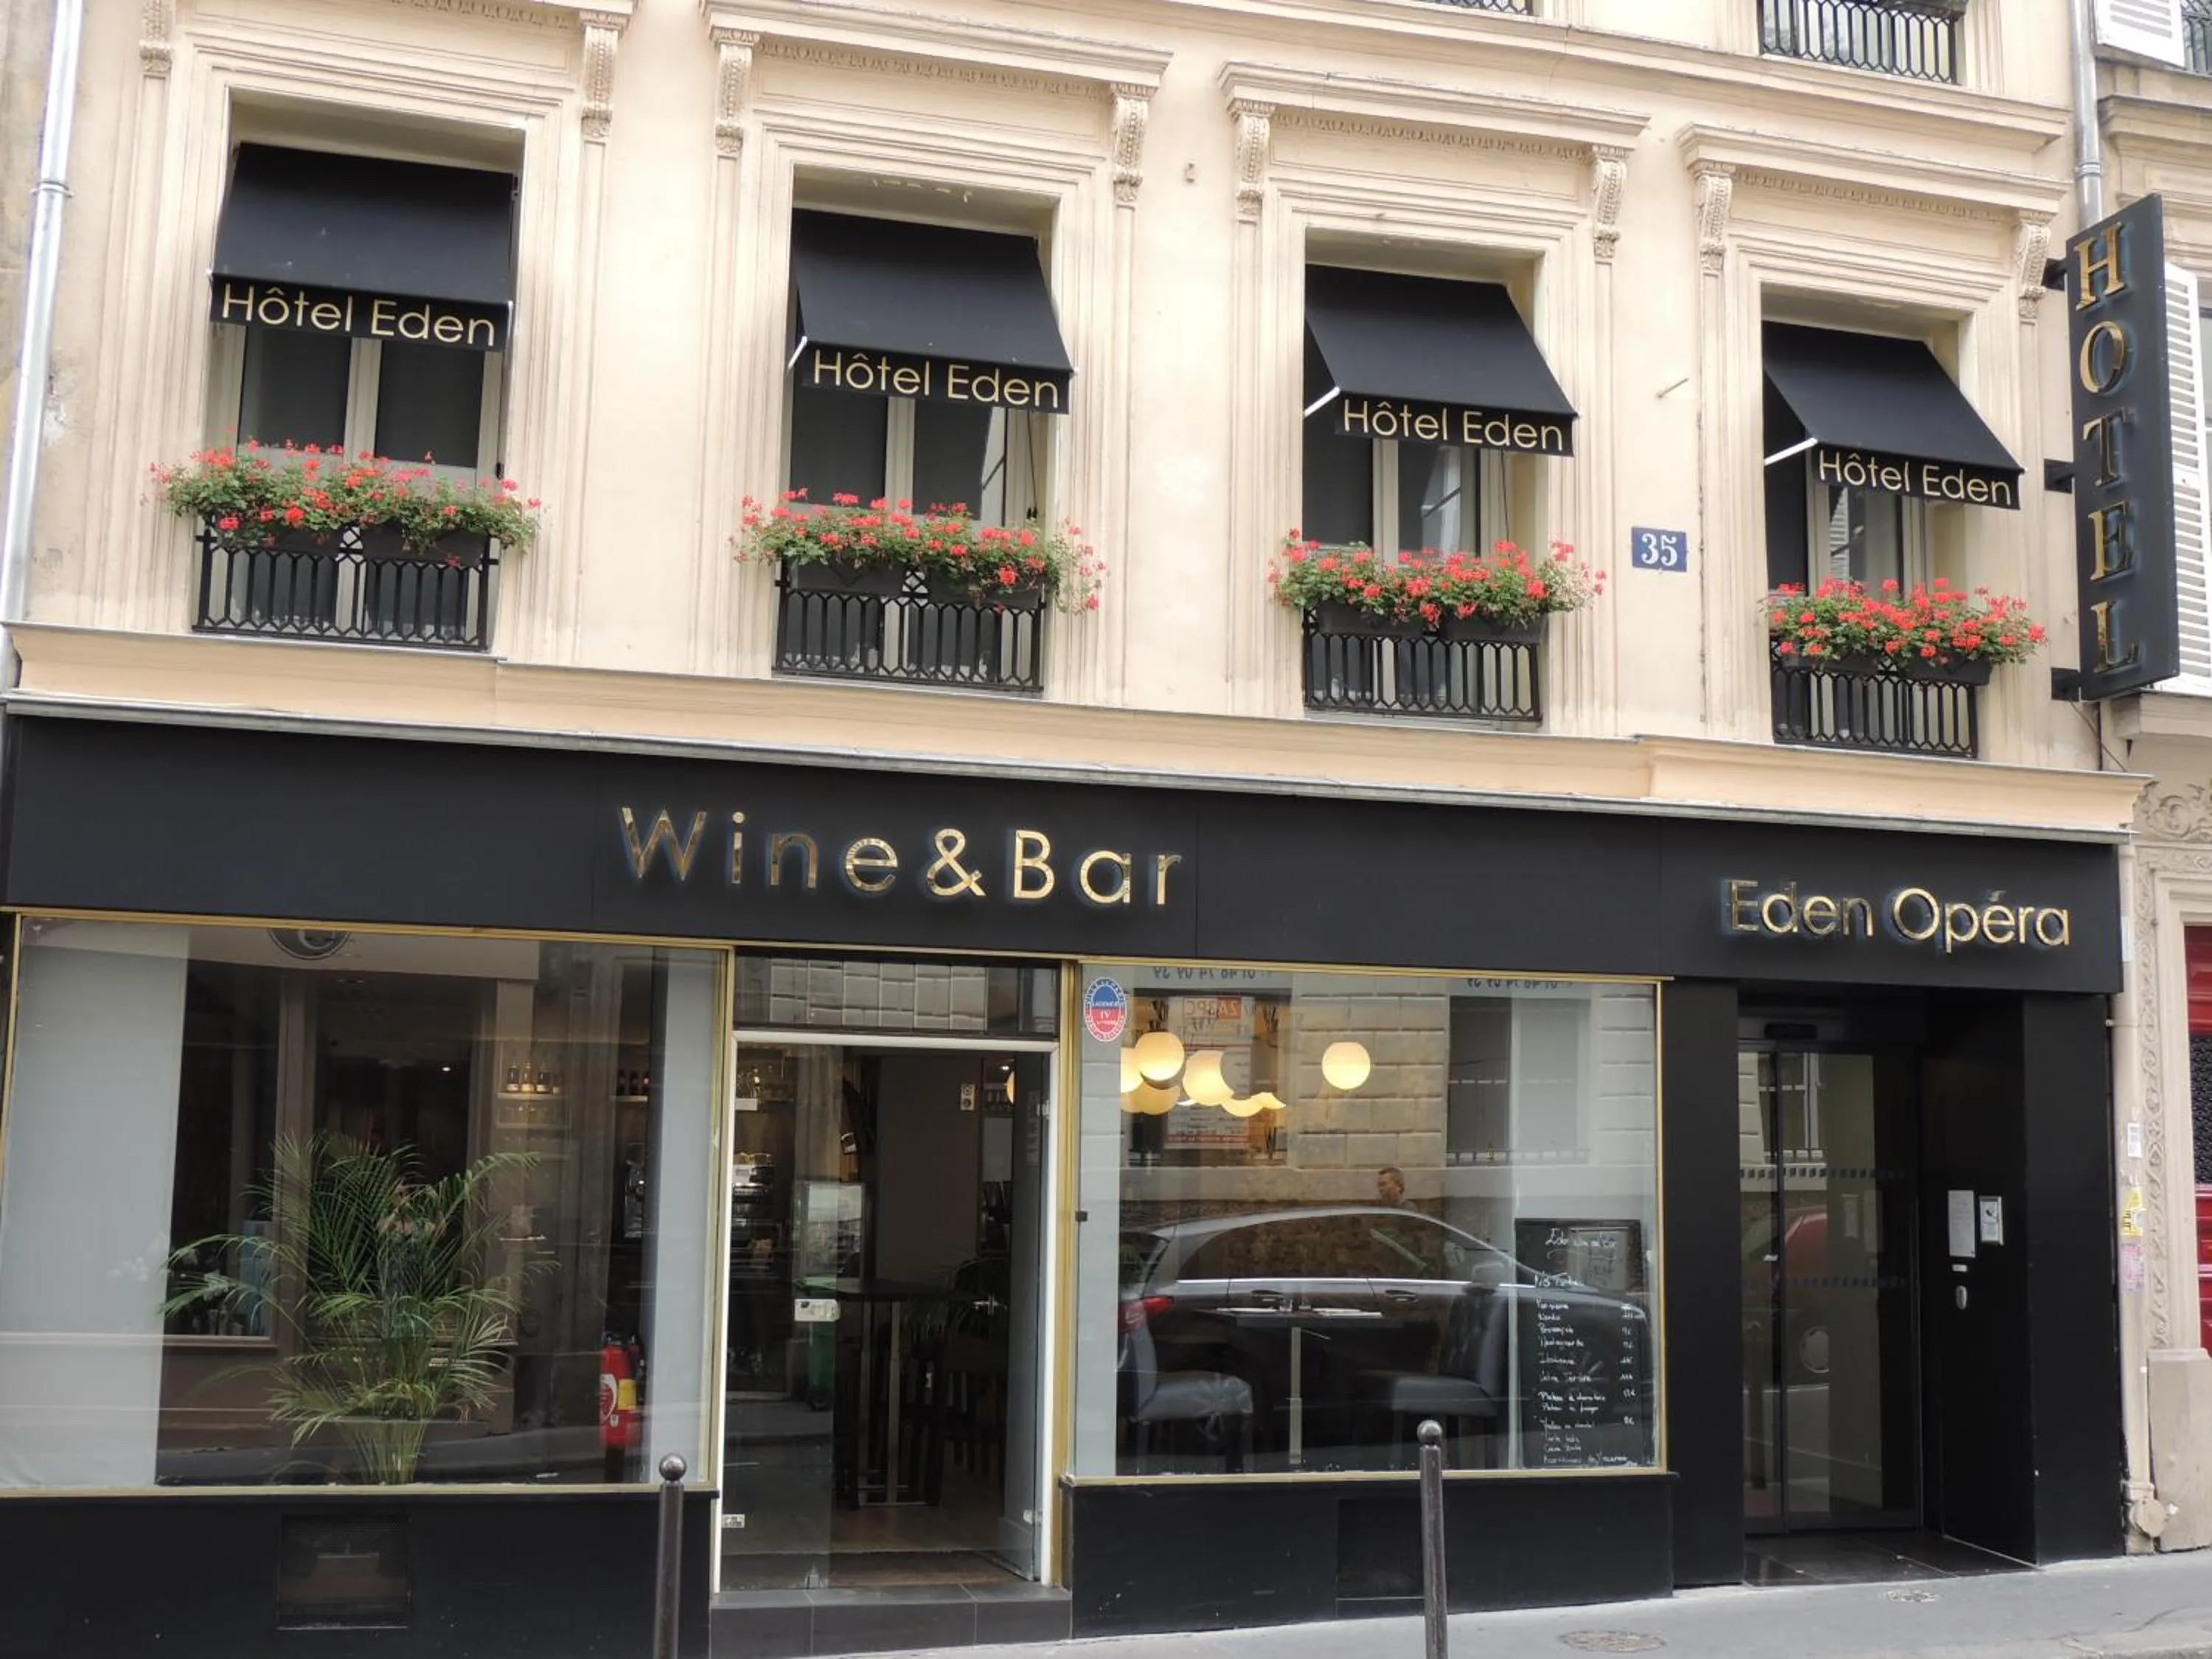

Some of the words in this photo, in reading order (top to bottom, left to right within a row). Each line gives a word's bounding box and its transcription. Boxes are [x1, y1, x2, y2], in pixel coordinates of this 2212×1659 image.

[222, 283, 352, 332] Hôtel
[371, 299, 495, 347] Eden
[815, 349, 930, 396] Hôtel
[947, 364, 1058, 408] Eden
[1344, 399, 1448, 441] Hôtel
[1463, 411, 1563, 451] Eden
[2073, 222, 2137, 674] HOTEL
[1819, 450, 1910, 493] Hôtel
[1922, 465, 2011, 505] Eden
[1641, 533, 1678, 566] 35
[1729, 880, 1874, 936] Eden
[1893, 886, 2070, 953] Opéra
